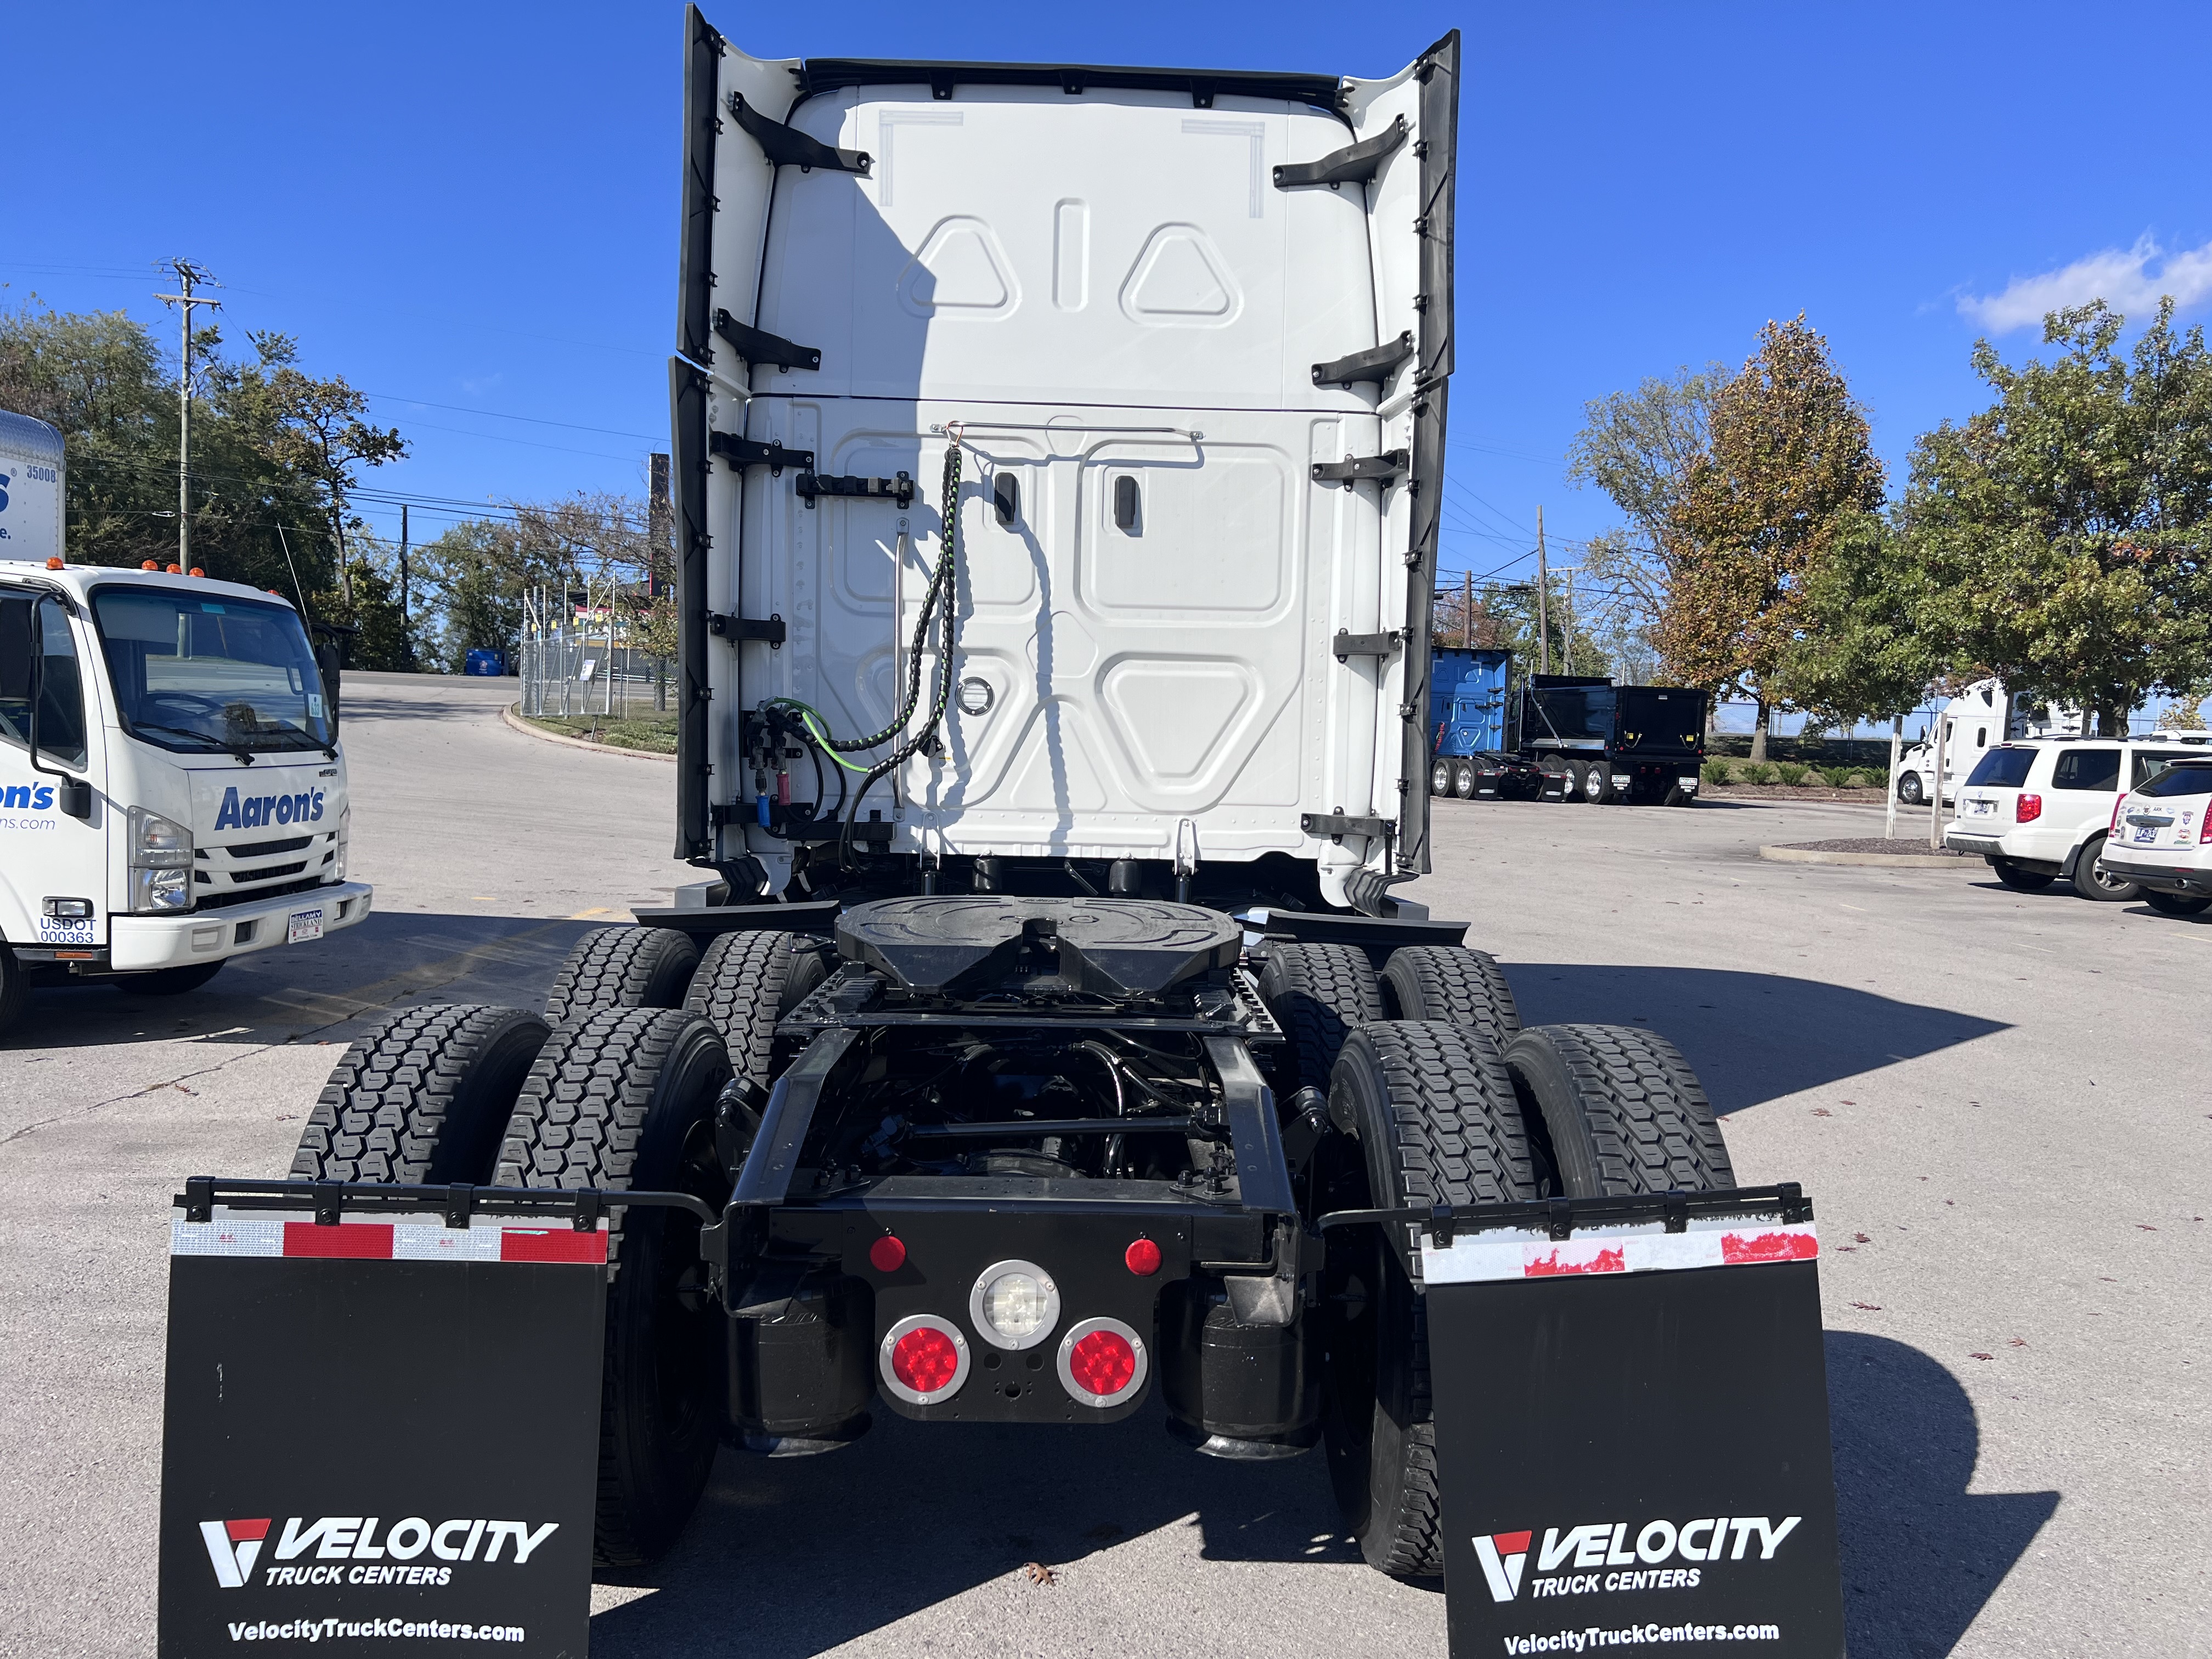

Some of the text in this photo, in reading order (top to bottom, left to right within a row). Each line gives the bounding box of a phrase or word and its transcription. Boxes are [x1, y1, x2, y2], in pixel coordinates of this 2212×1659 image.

[27, 465, 56, 483] 35008
[214, 786, 324, 831] Aaron's
[41, 918, 97, 930] USDOT
[291, 911, 321, 922] BELLAMY
[291, 917, 322, 930] STRICKLAND
[41, 931, 94, 943] 000363
[274, 1517, 560, 1564] VELOCITY
[1537, 1516, 1802, 1571] VELOCITY
[266, 1566, 452, 1587] TRUCK CENTERS
[1532, 1568, 1701, 1598] TRUCK CENTERS
[227, 1618, 525, 1643] VelocityTruckCenters.com
[1504, 1622, 1779, 1656] VelocityTruckCenters.com
